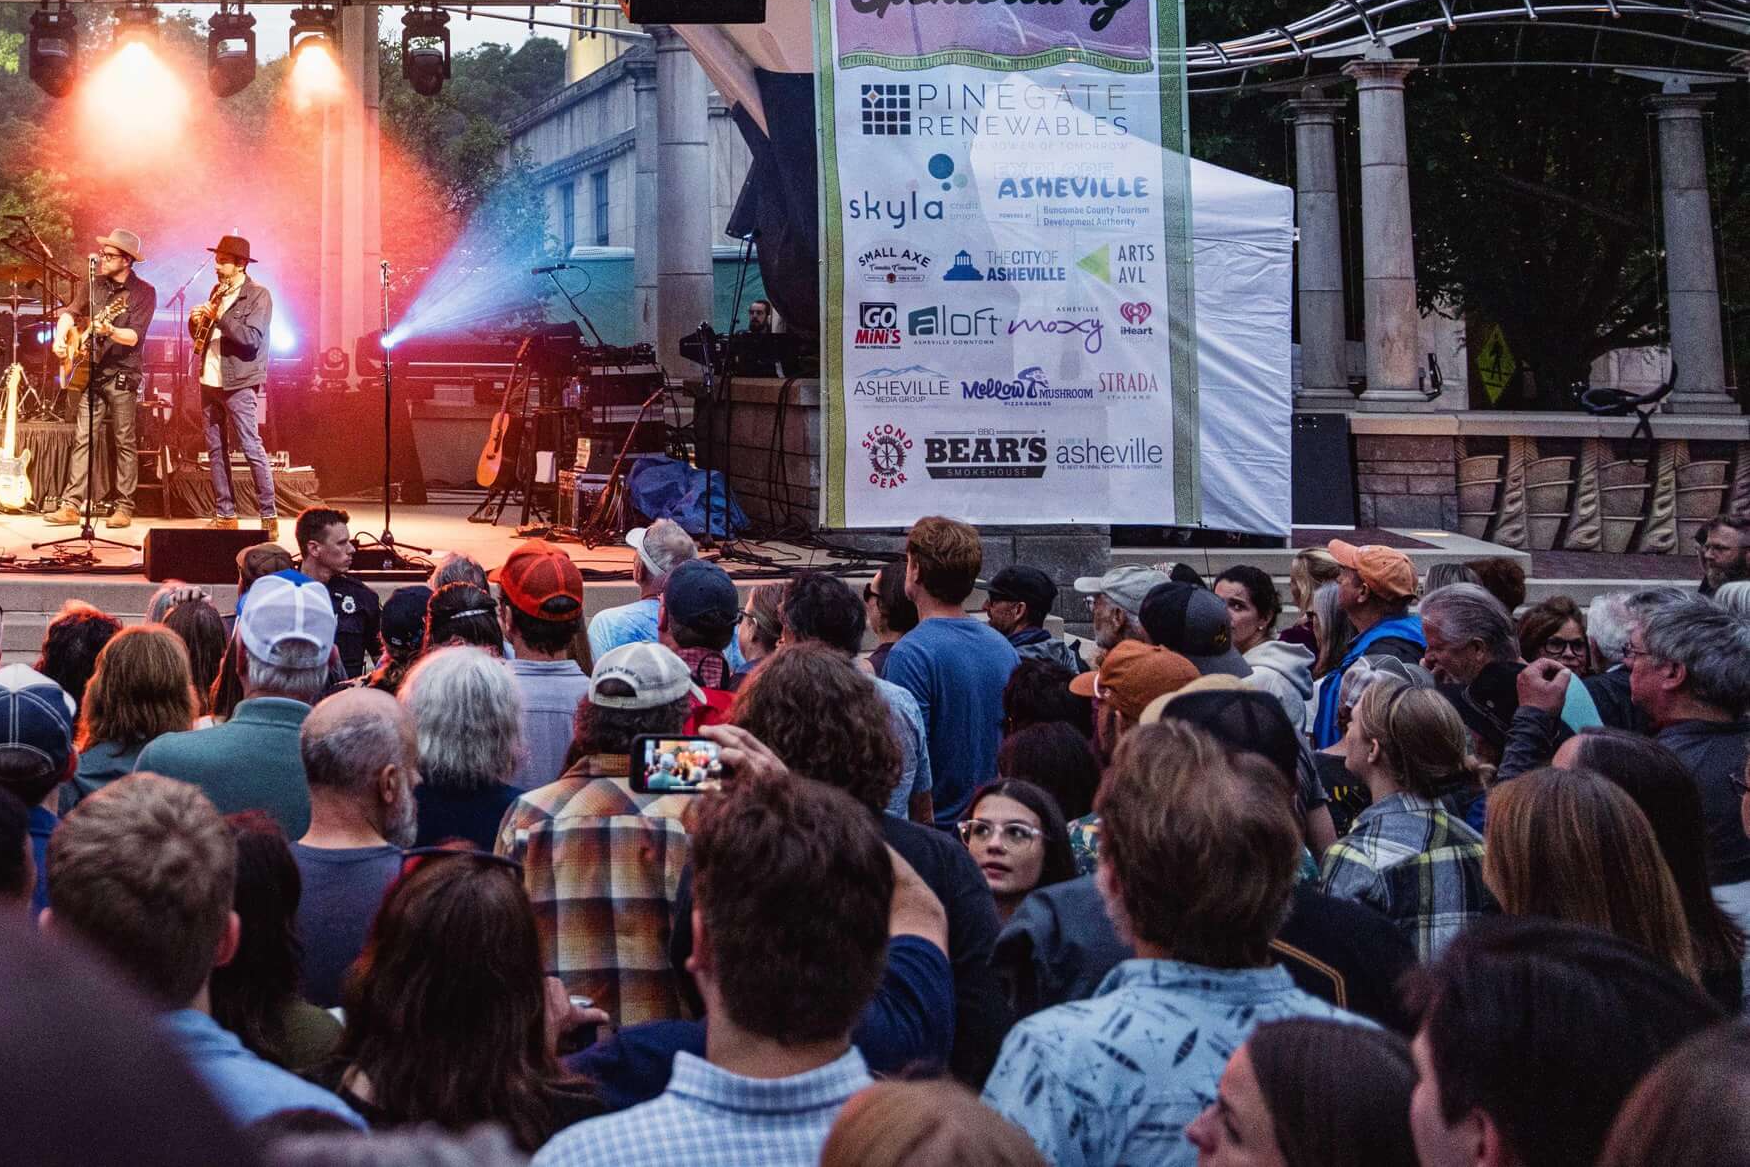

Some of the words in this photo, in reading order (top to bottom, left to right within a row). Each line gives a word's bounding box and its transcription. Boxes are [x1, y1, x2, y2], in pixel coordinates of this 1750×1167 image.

[918, 116, 1129, 136] RENEWABLES
[993, 162, 1115, 180] EXPLORE
[997, 176, 1150, 200] ASHEVILLE
[849, 190, 944, 230] skyla
[1043, 205, 1084, 215] Buncombe
[1086, 205, 1115, 216] County
[1117, 205, 1150, 215] Tourism
[1043, 217, 1095, 228] Development
[1097, 217, 1136, 228] Authority
[858, 247, 898, 267] SMALL
[901, 249, 931, 269] AXE
[1118, 244, 1155, 262] ARTS
[986, 267, 1066, 281] ASHEVILLE
[1118, 265, 1146, 284] AVL
[864, 306, 897, 328] GO
[909, 304, 998, 337] aloft
[1008, 318, 1104, 354] moxy
[1120, 326, 1153, 335] iHeart
[854, 380, 951, 396] ASHEVILLE
[961, 377, 1025, 400] Mellow
[1039, 388, 1094, 399] MUSHROOM
[1098, 372, 1159, 393] STRADA
[862, 424, 914, 450] SECOND
[924, 437, 1047, 463] BEAR'S
[1056, 437, 1163, 464] asheville
[869, 472, 908, 489] GEAR
[947, 468, 1027, 477] SMOKEHOUSE
